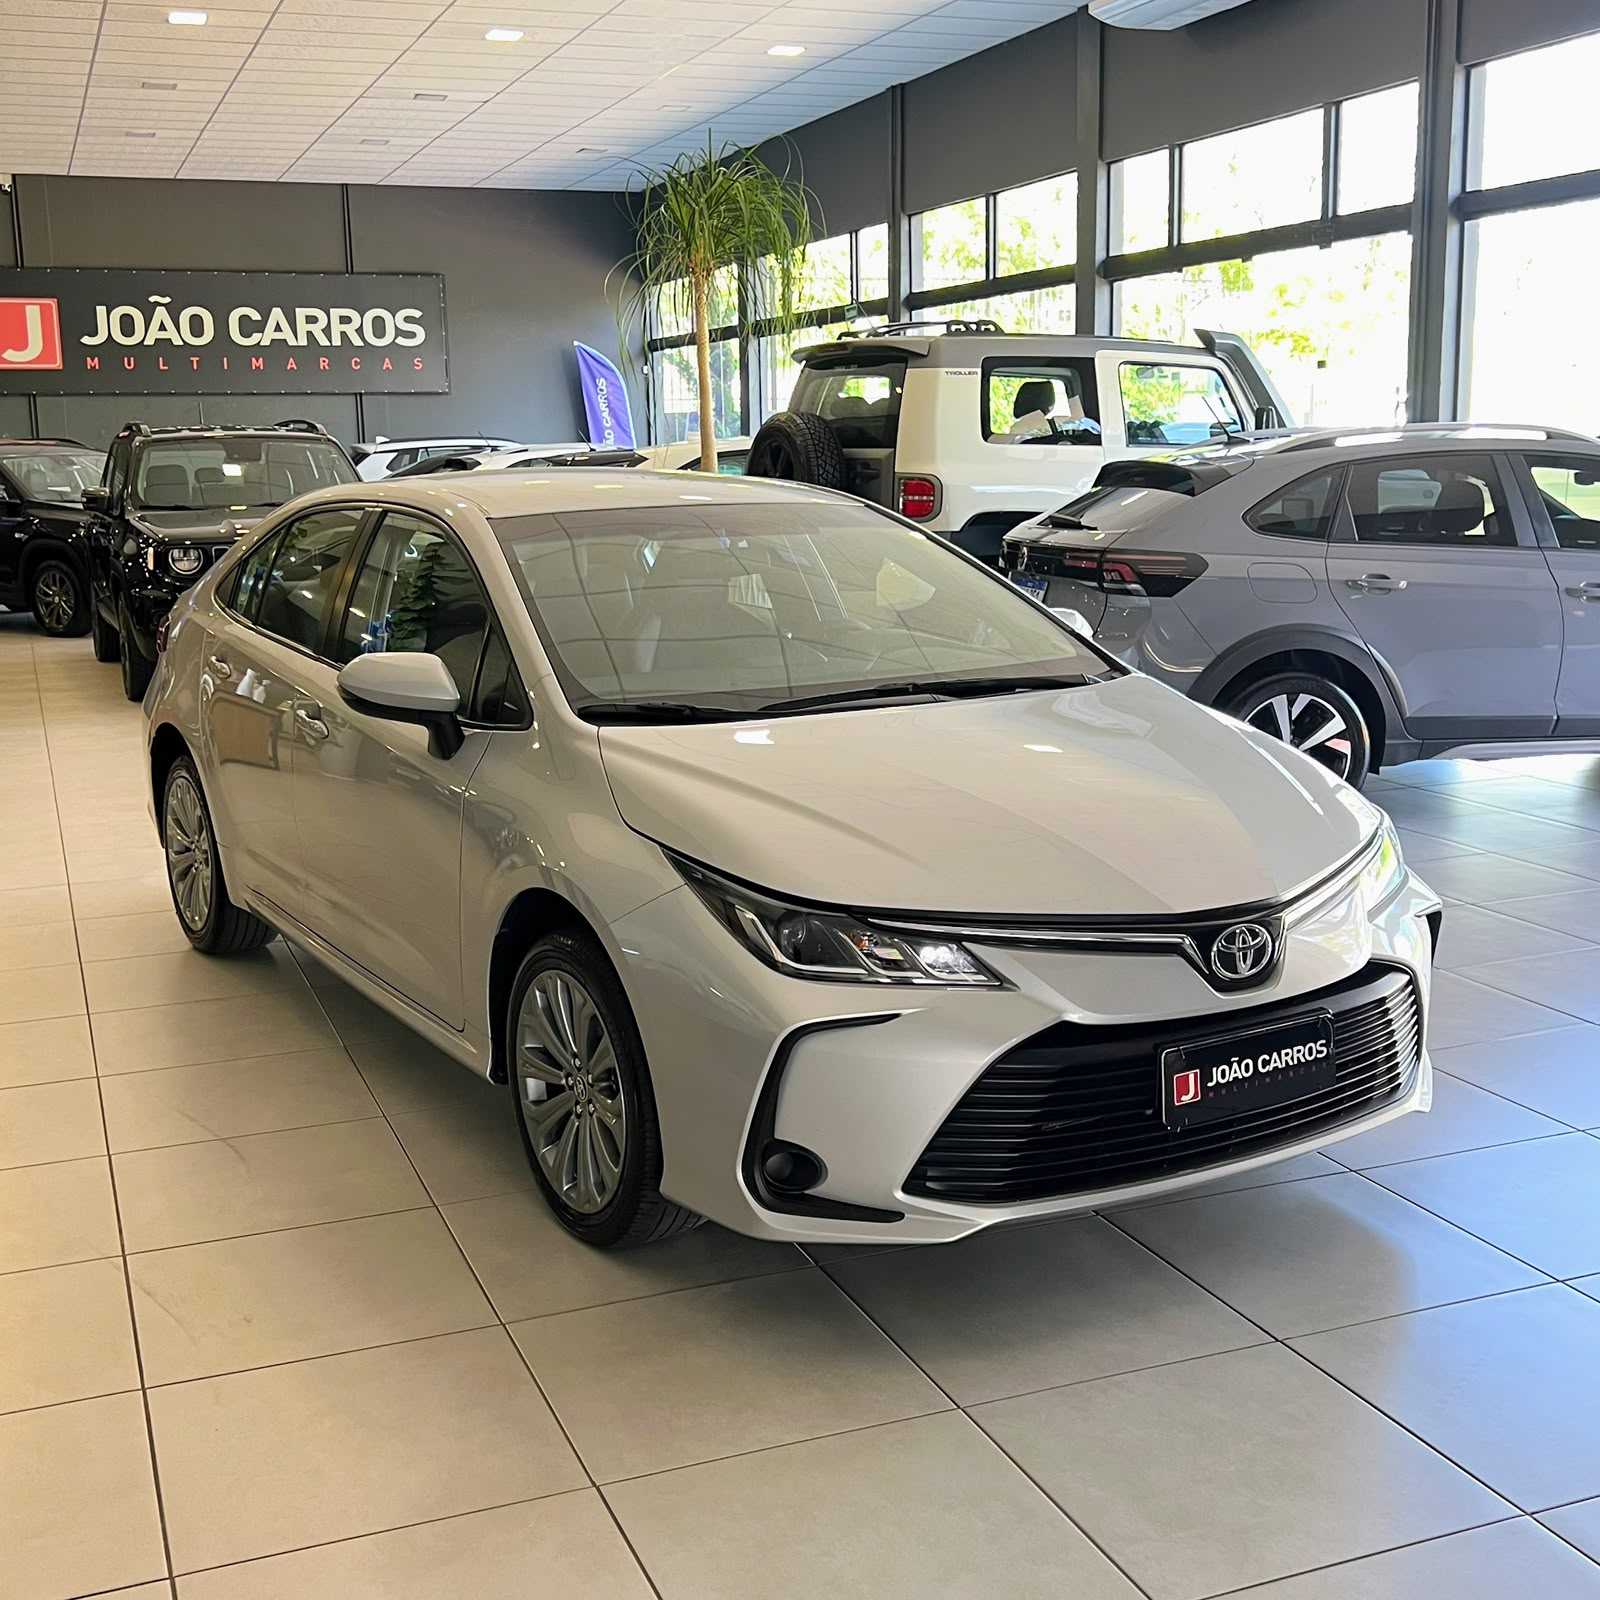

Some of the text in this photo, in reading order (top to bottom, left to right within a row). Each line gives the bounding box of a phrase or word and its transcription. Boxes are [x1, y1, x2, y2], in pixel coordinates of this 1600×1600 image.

[1, 305, 43, 363] J
[80, 295, 426, 348] JOÃO CARROS
[86, 356, 424, 371] MULTIMARCAS
[596, 378, 611, 427] CARROS
[1207, 1057, 1253, 1086] JOÃO
[1257, 1040, 1327, 1073] CARROS
[1180, 1073, 1196, 1101] J
